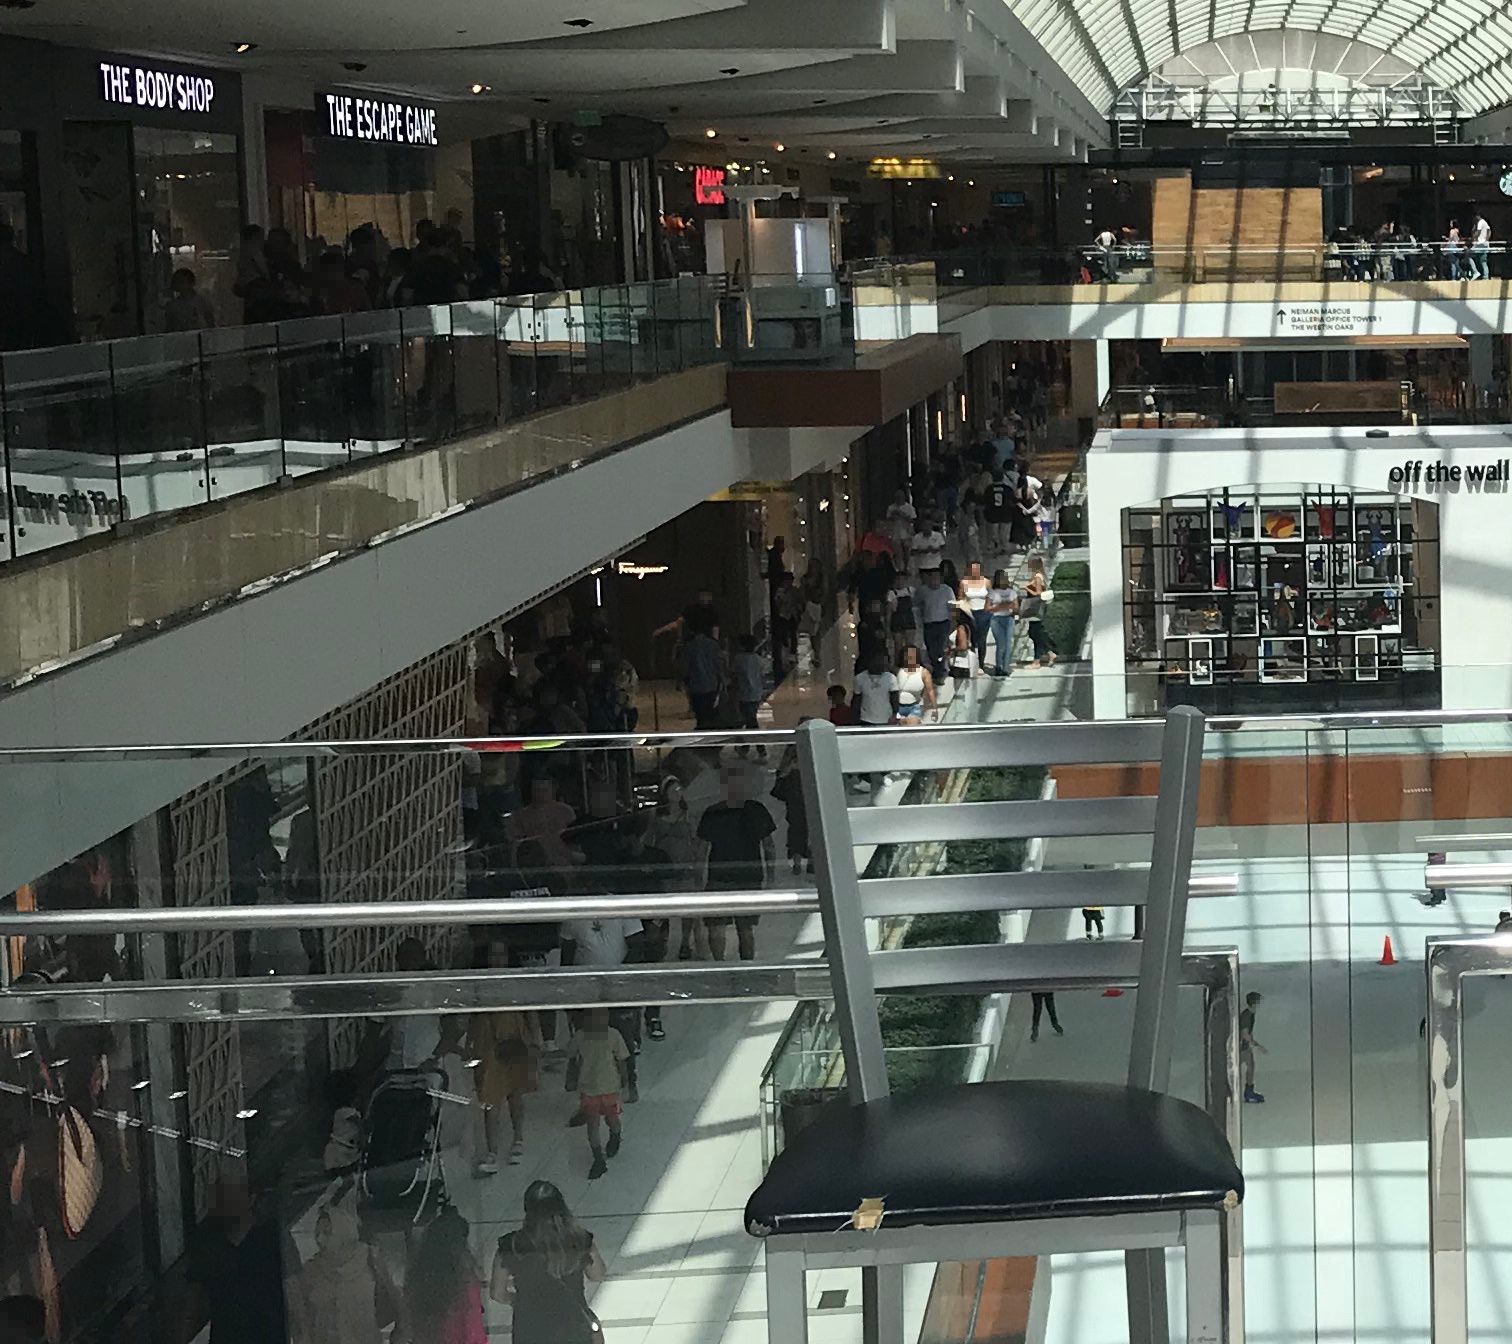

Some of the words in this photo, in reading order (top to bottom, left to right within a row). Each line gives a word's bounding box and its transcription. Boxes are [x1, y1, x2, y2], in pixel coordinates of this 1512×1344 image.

[100, 63, 131, 104] THE
[135, 68, 176, 110] BODY
[175, 74, 214, 113] SHOP
[326, 94, 353, 137] THE
[355, 98, 405, 143] ESCAPE
[405, 104, 439, 146] GAME
[1389, 460, 1423, 483] off
[1426, 460, 1461, 483] the
[1467, 459, 1510, 482] wall
